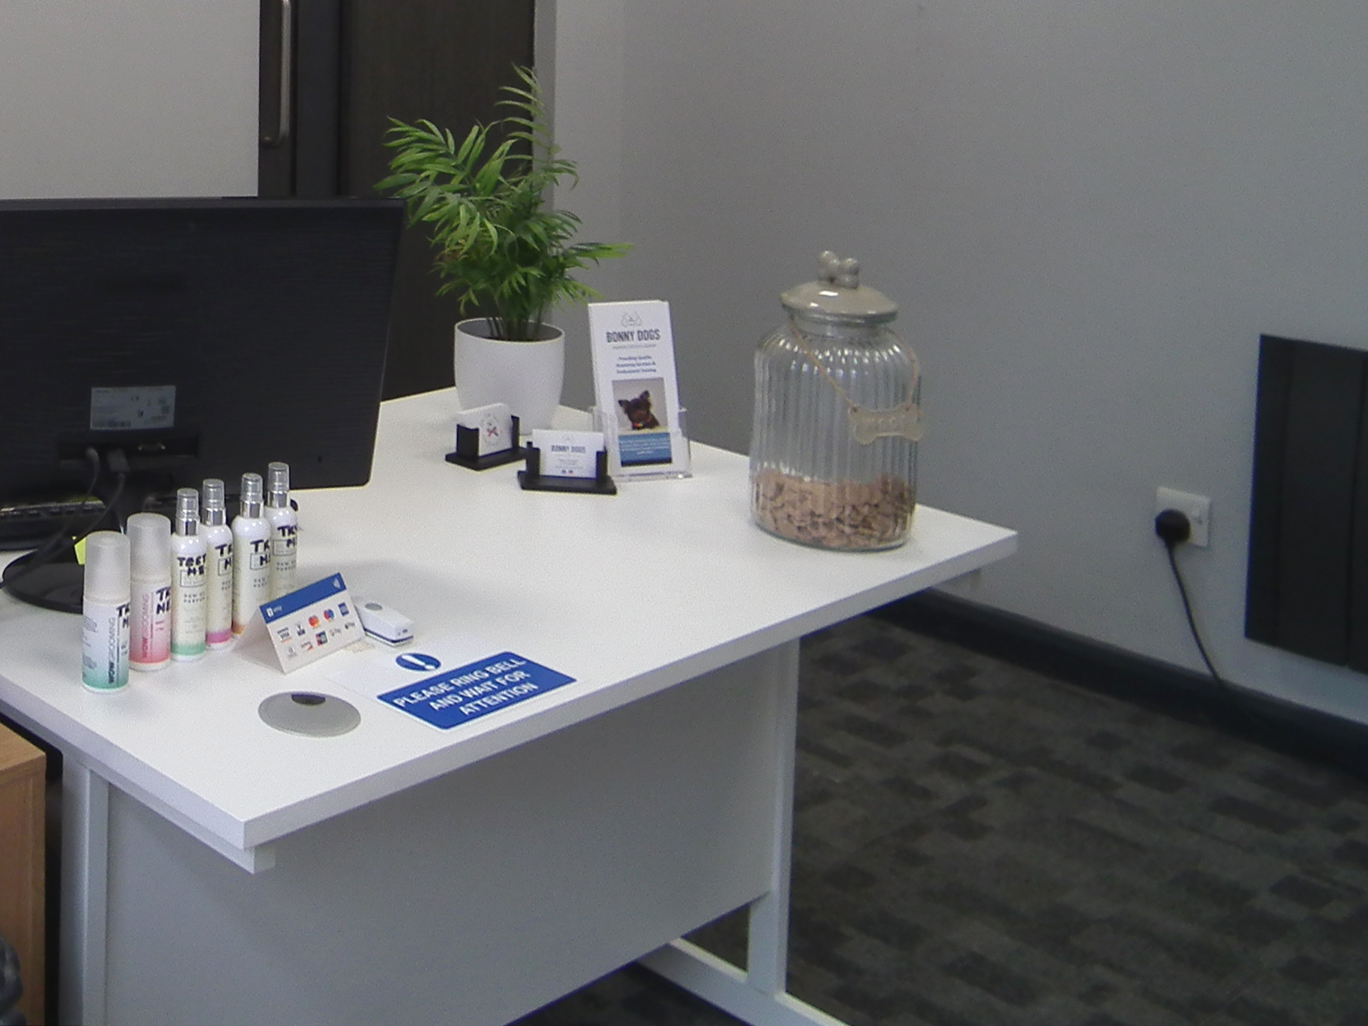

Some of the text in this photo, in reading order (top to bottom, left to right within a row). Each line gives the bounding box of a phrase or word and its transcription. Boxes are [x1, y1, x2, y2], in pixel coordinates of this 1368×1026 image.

[606, 329, 661, 343] BONNY DOGS
[393, 657, 527, 708] PLEASE RING BELL
[429, 669, 531, 712] AND WAIT FOR
[459, 682, 539, 715] ATTENTION
